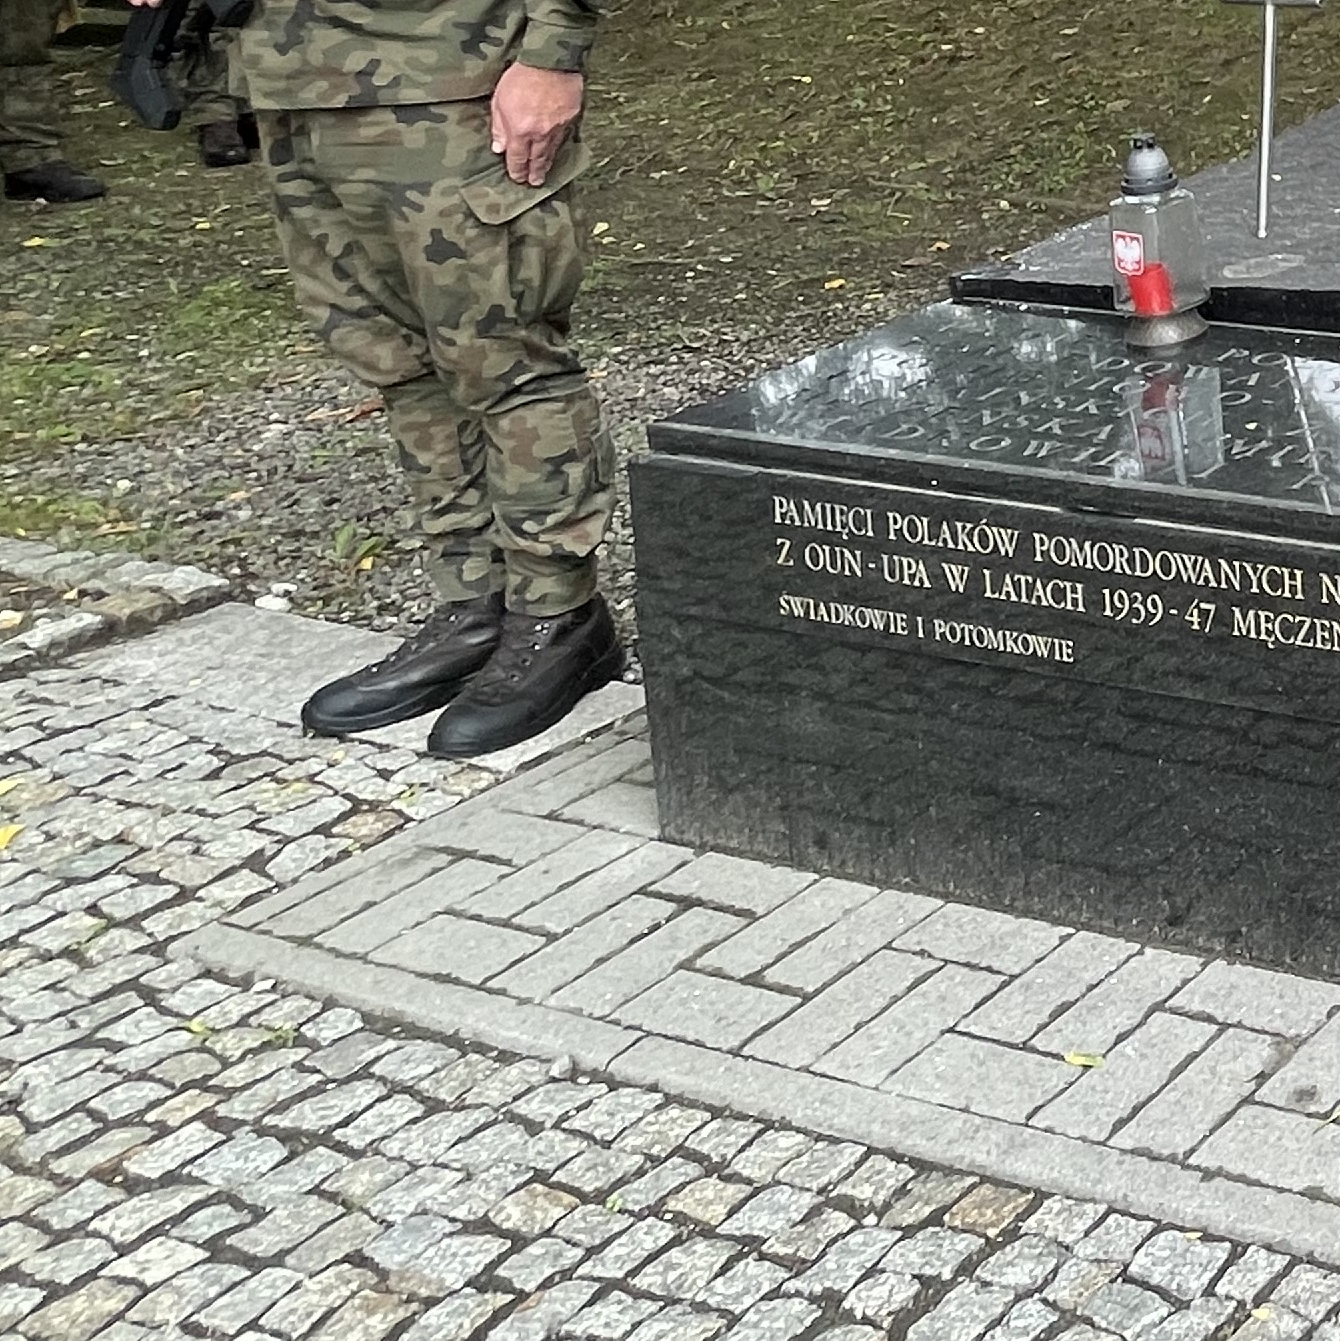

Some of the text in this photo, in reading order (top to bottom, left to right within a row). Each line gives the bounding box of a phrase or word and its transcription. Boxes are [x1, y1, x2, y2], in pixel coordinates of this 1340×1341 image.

[772, 495, 874, 540] PAMIĘCI
[886, 511, 1020, 558] POLAKÓW
[1032, 532, 1305, 600] POMORDOWANYCH
[776, 537, 794, 566] Z
[940, 562, 970, 594] W
[982, 568, 1086, 613] LATACH
[778, 594, 1075, 663] ŚWIADKOWIE I POTOMKOWIE
